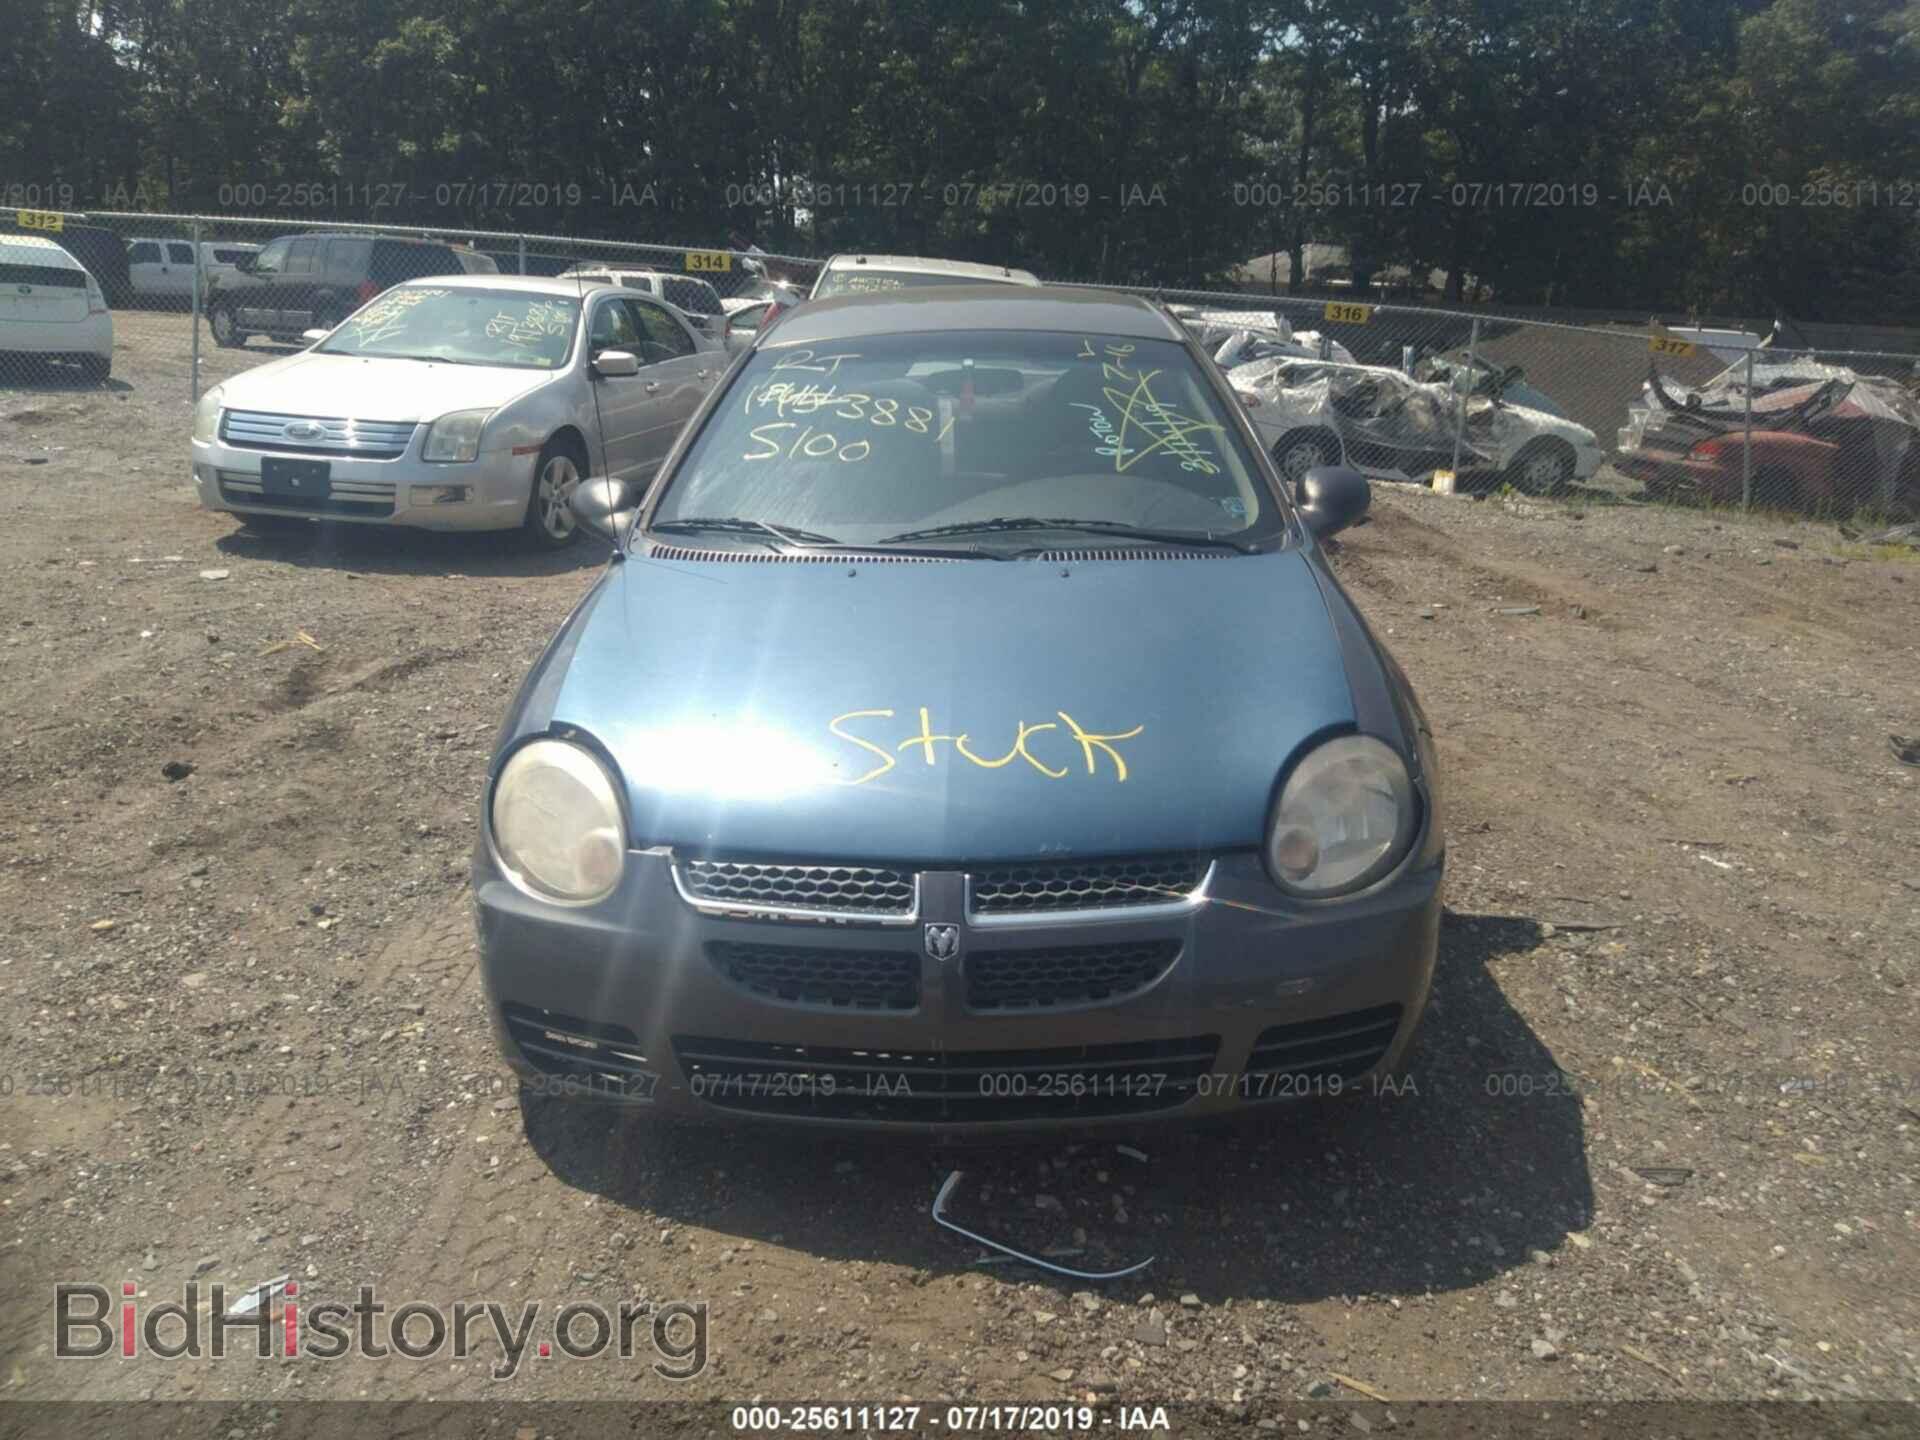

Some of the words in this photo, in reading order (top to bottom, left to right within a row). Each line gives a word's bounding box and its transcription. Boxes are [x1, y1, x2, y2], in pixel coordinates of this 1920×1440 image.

[692, 254, 724, 269] 314
[1330, 304, 1362, 321] 316
[764, 350, 862, 380] RT
